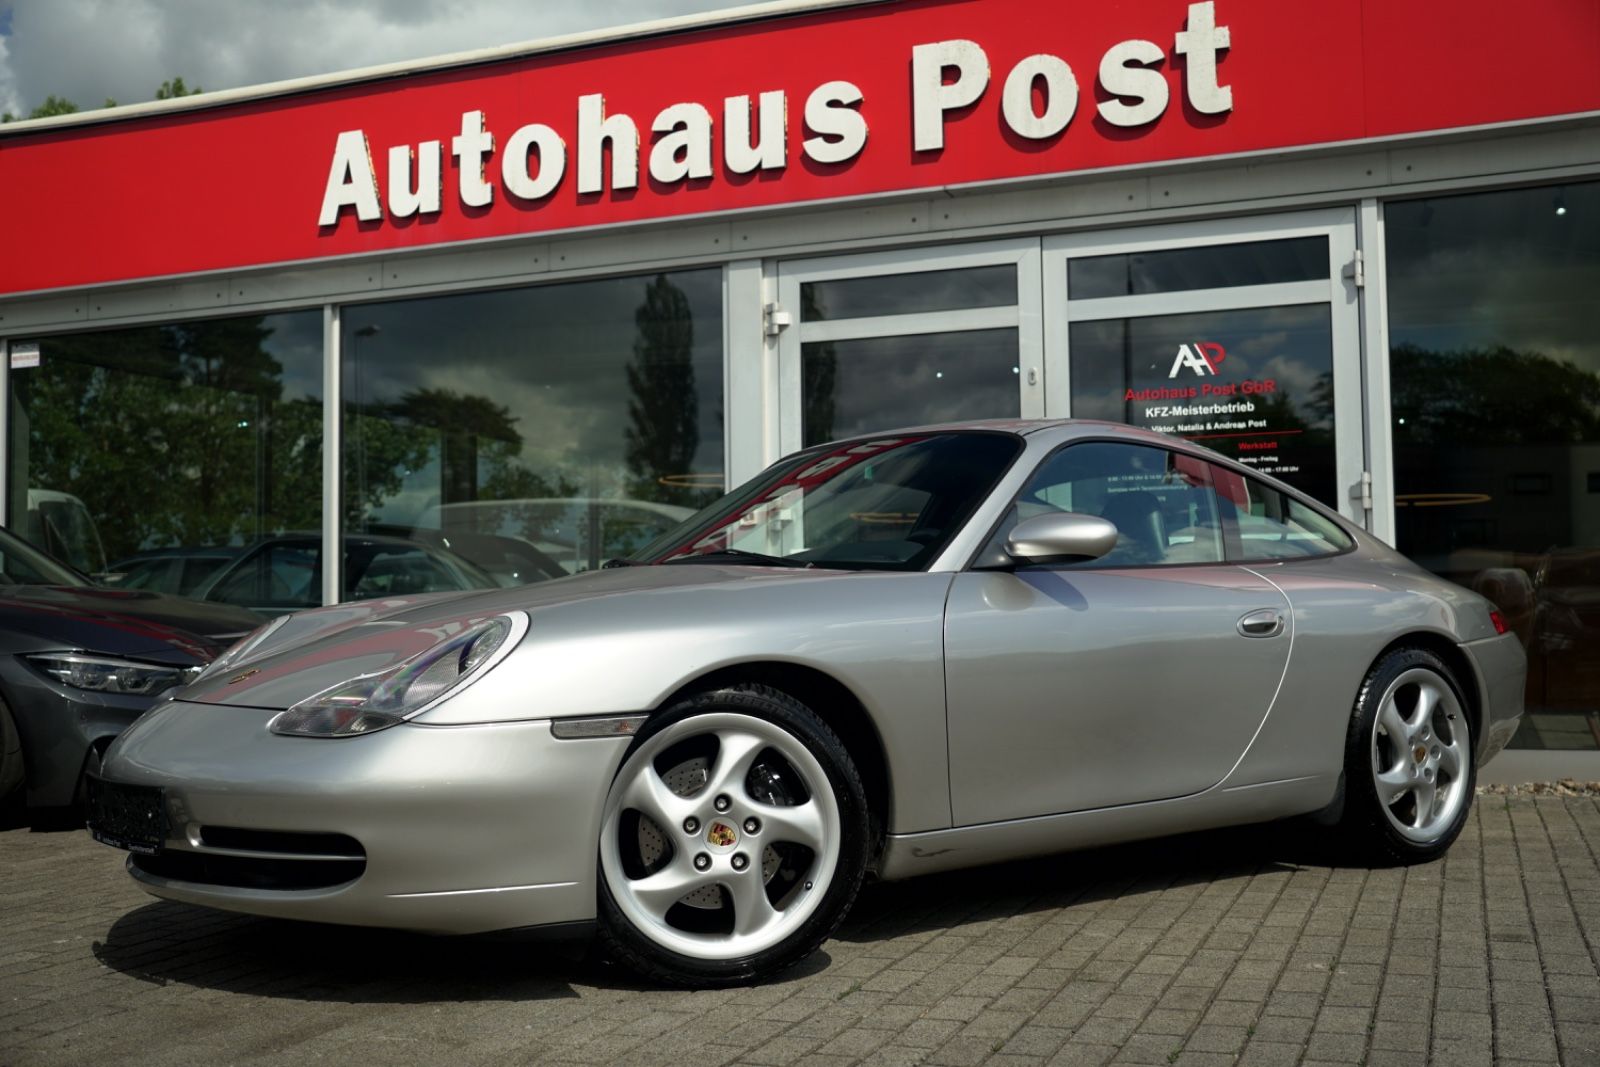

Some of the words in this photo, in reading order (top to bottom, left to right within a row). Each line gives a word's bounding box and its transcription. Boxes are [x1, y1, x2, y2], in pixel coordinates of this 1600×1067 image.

[318, 80, 869, 226] Autohaus
[912, 1, 1233, 151] Post
[1124, 385, 1197, 401] Autohaus
[1202, 383, 1236, 396] Post
[1241, 379, 1276, 394] GbR
[1145, 401, 1255, 418] KFZ-Meisterbetrieb
[1177, 422, 1204, 432] Natalia
[1206, 422, 1212, 430] &
[1213, 420, 1247, 430] Andreas
[1248, 418, 1267, 428] Post
[1238, 441, 1277, 449] Werkstatt
